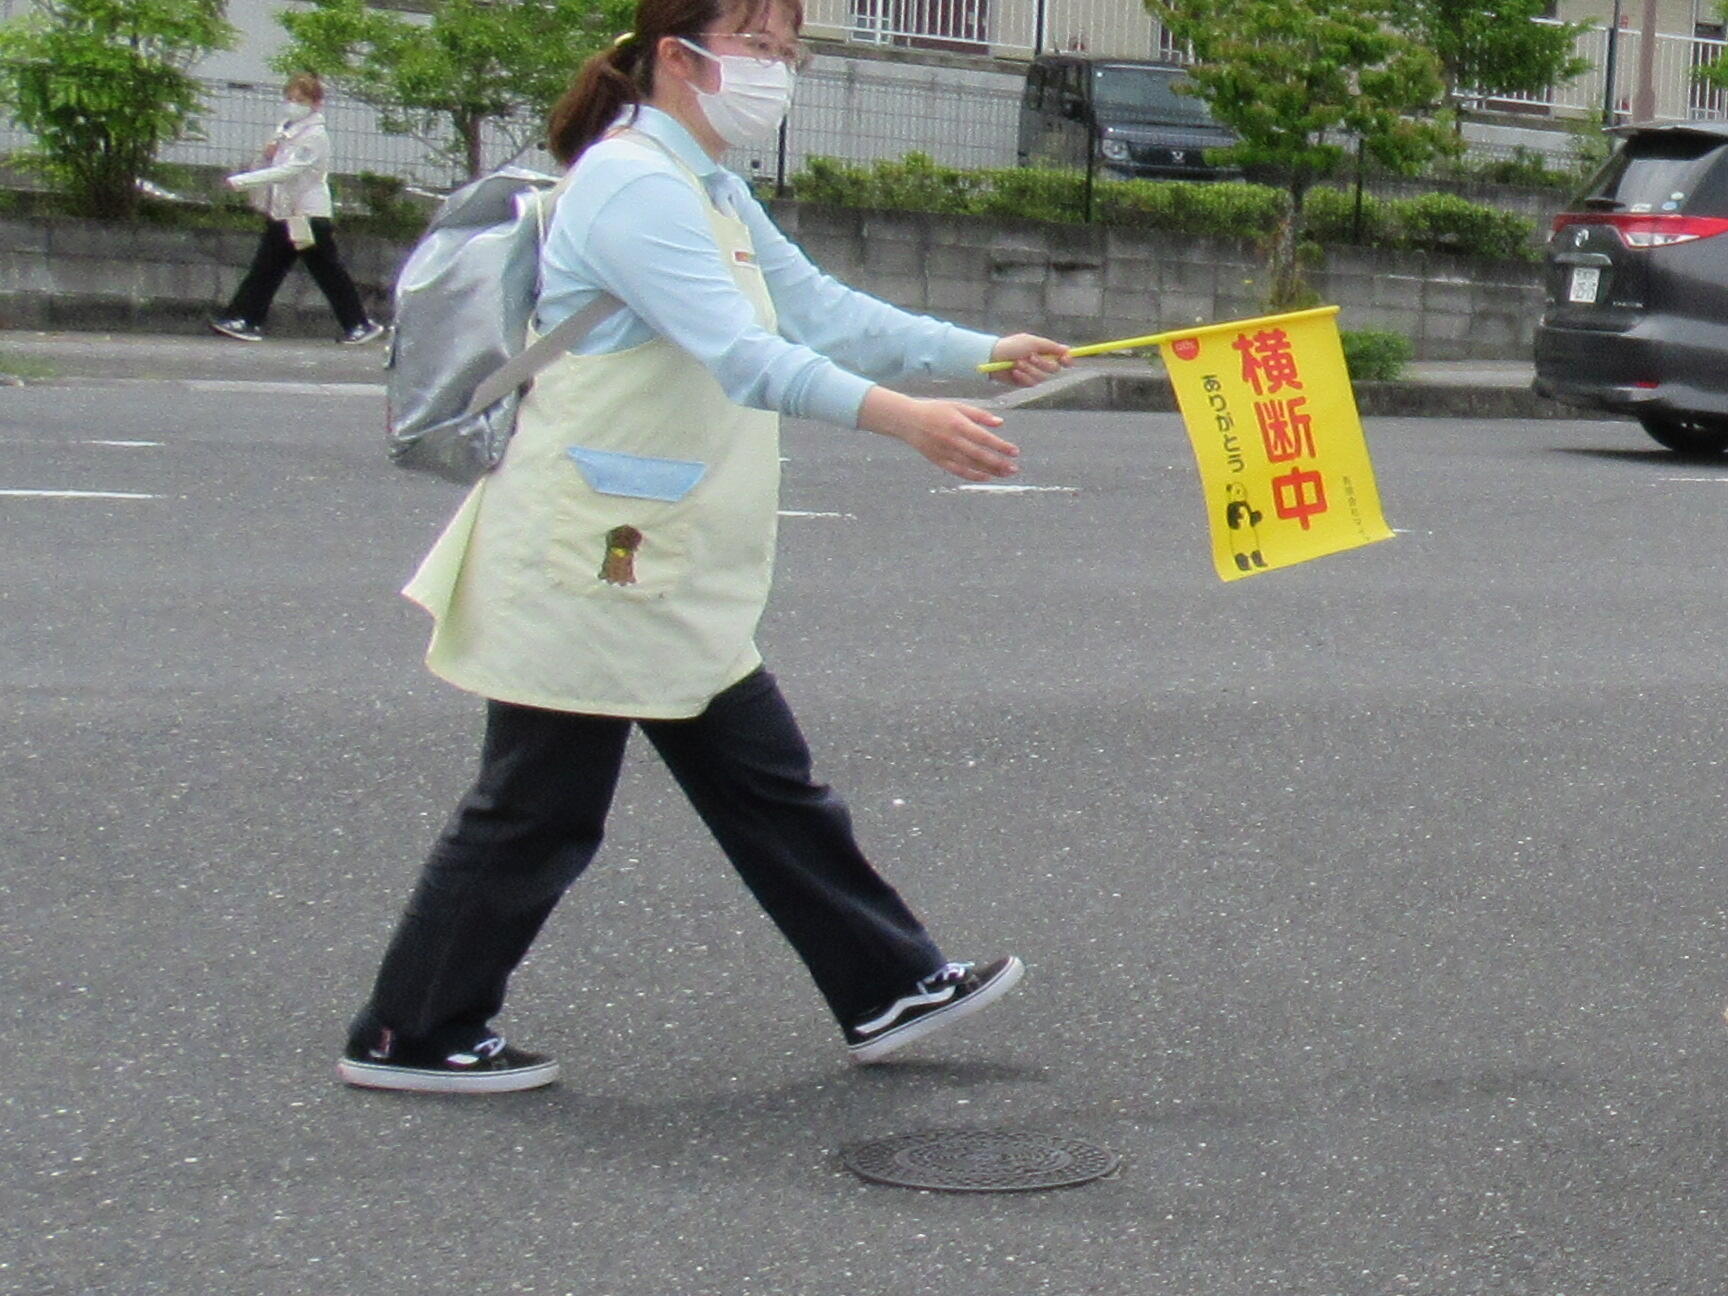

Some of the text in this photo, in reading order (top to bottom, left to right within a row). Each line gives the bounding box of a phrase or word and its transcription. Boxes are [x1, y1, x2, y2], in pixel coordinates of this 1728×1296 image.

[1201, 372, 1245, 474] ありがとう
[1231, 327, 1328, 531] 横断中
